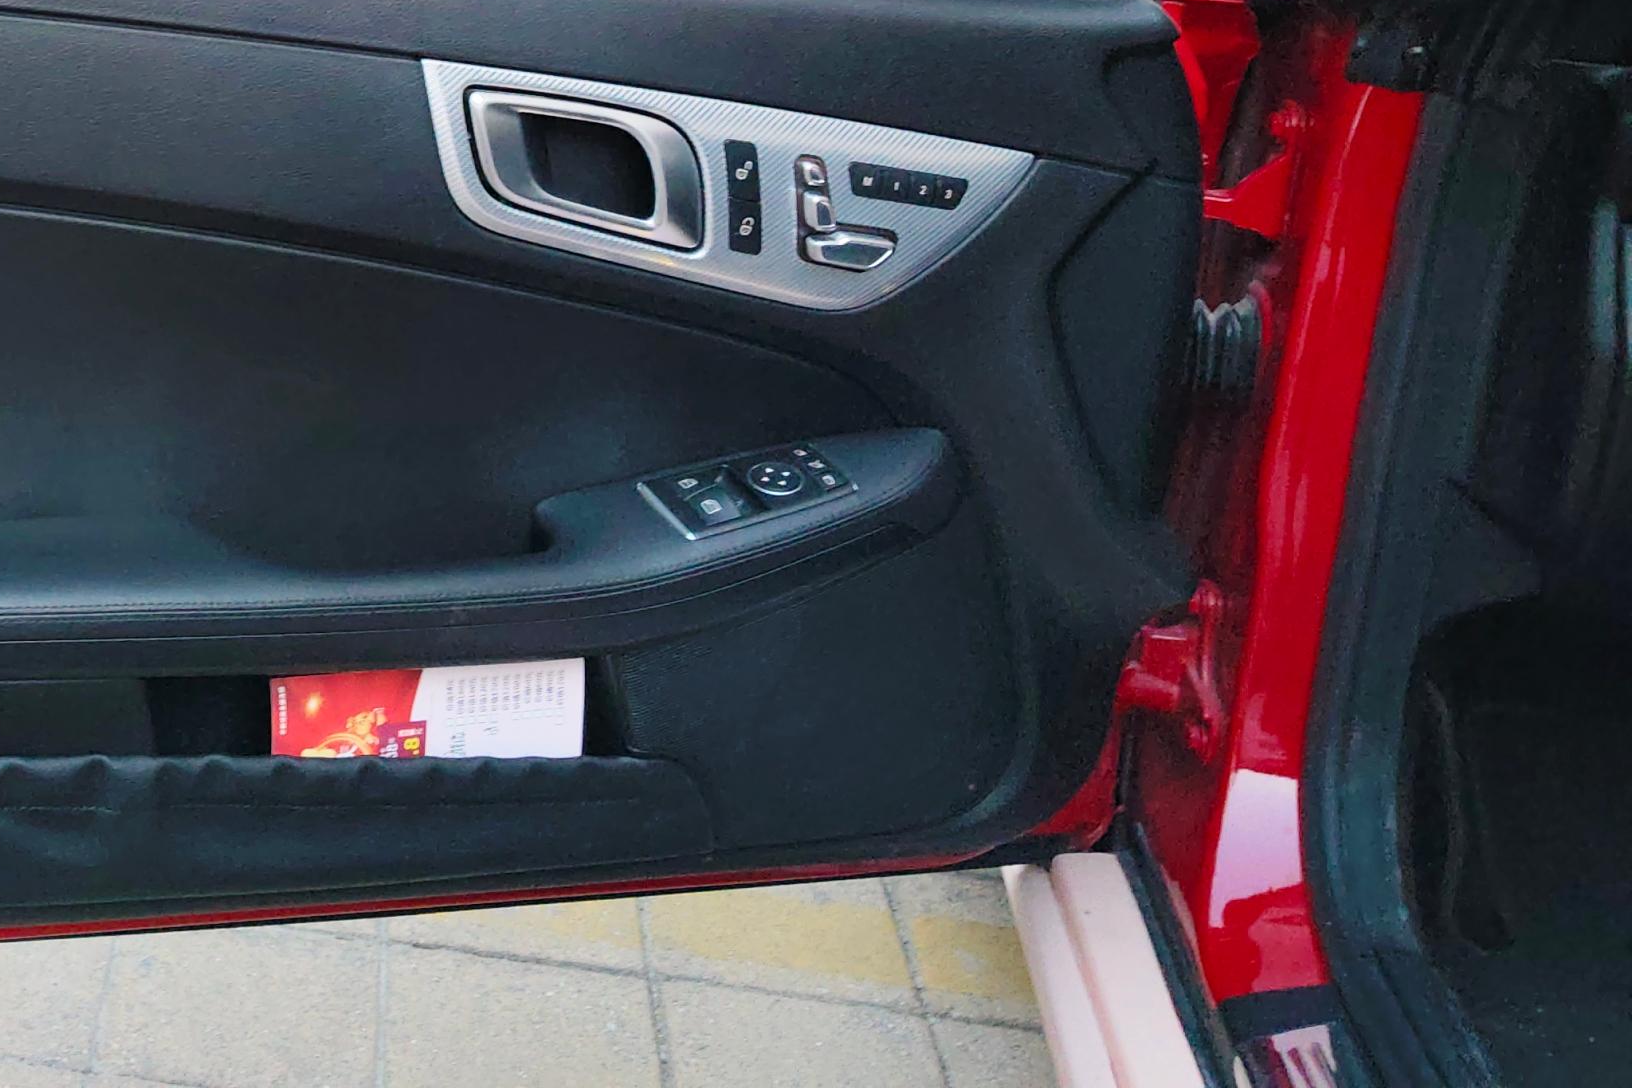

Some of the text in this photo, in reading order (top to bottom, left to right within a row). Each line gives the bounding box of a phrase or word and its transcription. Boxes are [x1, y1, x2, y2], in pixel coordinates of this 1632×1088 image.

[893, 181, 900, 191] 1
[919, 184, 929, 195] 2
[944, 188, 954, 200] 3
